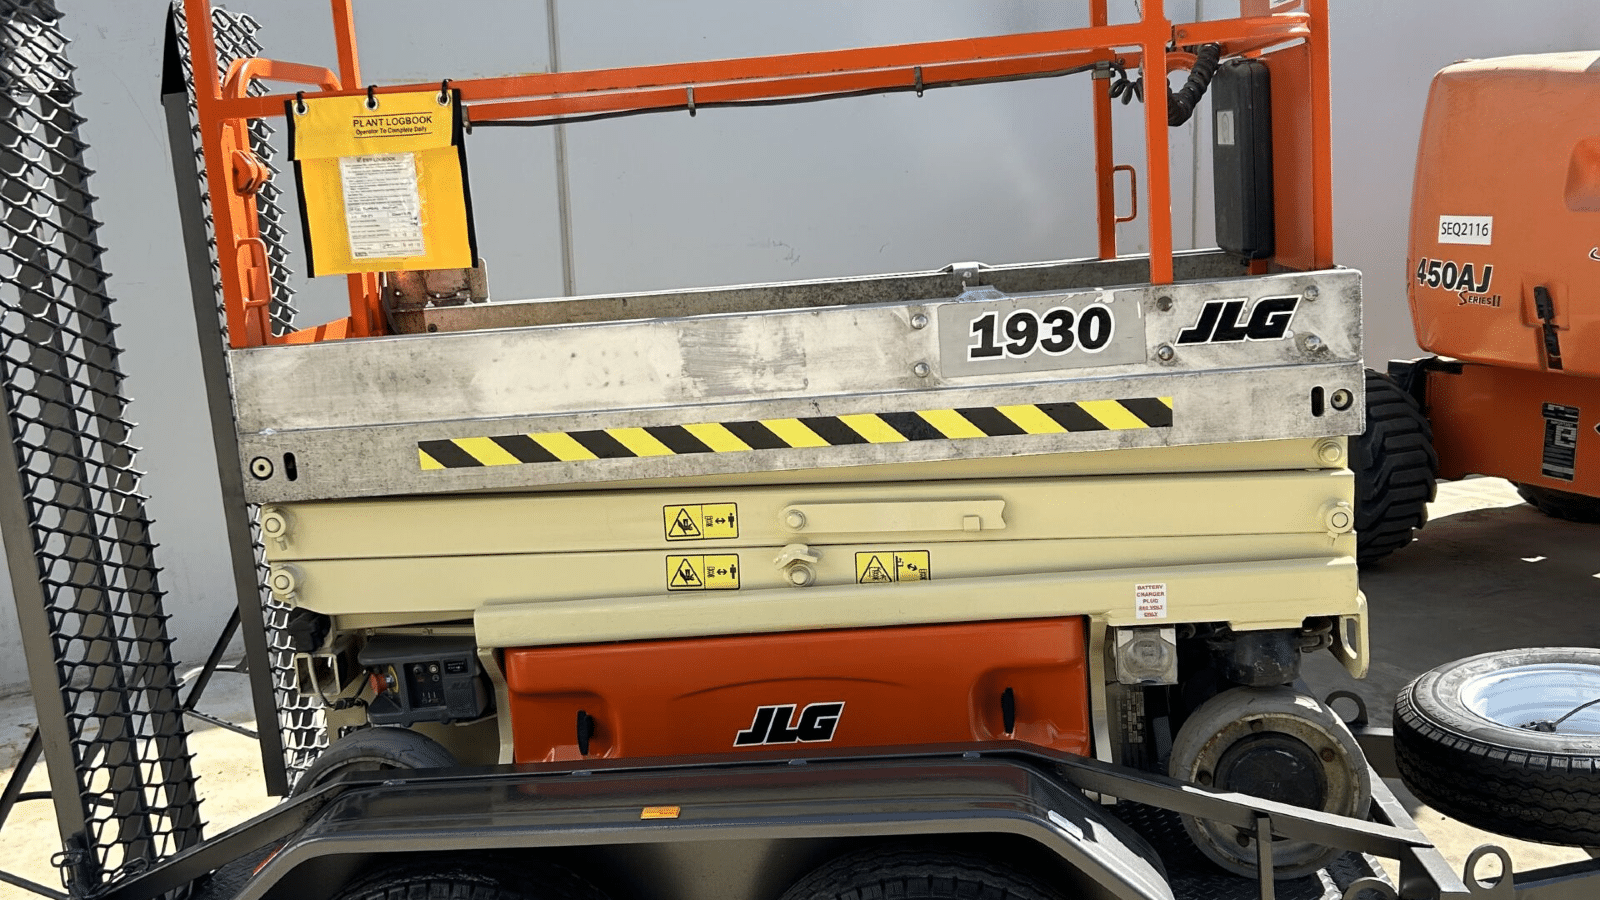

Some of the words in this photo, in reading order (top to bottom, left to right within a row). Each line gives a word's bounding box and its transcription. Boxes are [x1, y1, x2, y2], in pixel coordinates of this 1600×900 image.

[352, 118, 383, 127] PLANT
[386, 115, 432, 126] LOGBOOK
[387, 126, 413, 134] Complete
[1441, 222, 1489, 237] SEQ2116
[1417, 257, 1493, 294] 450AJ
[967, 303, 1115, 361] 1930
[1175, 294, 1303, 347] JLG
[733, 701, 846, 747] JLG
